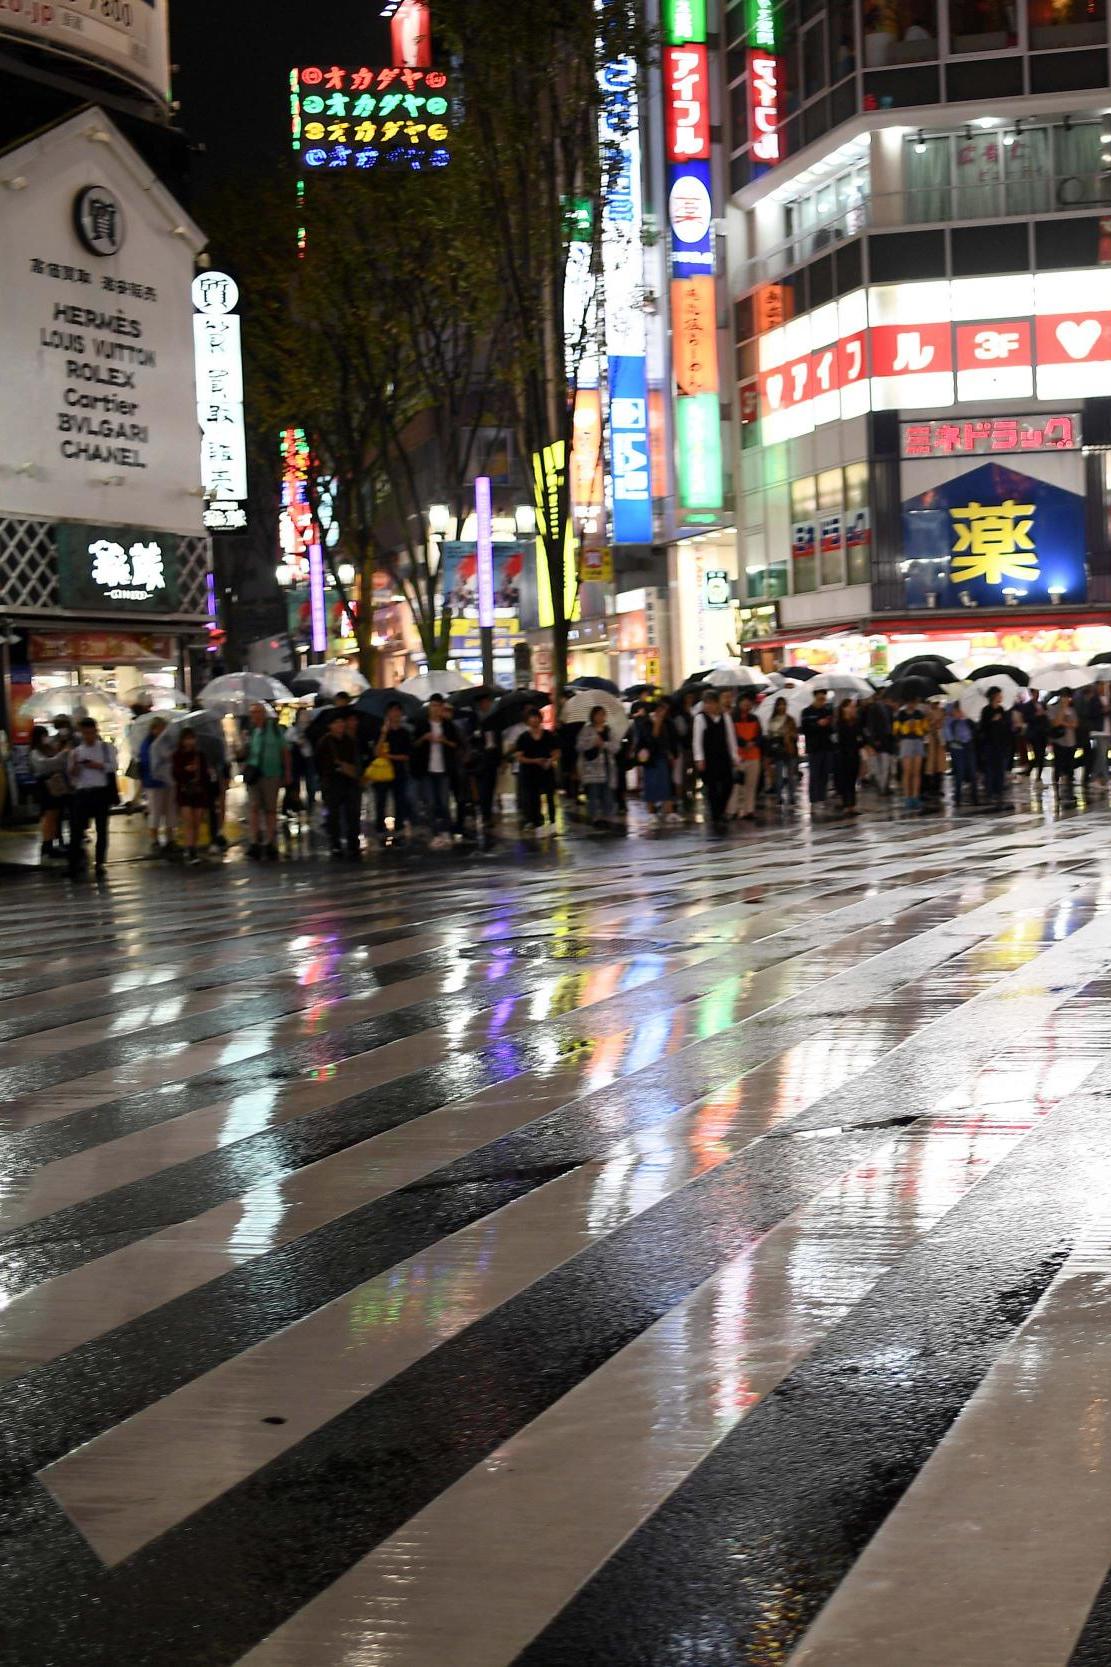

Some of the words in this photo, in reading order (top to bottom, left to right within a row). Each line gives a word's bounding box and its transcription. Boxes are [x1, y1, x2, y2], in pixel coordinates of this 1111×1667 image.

[671, 52, 704, 154] アイフル
[40, 328, 85, 354] LOUIS
[92, 338, 156, 368] VUITTON
[973, 331, 1021, 360] 3F
[66, 359, 136, 389] ROLEX
[63, 388, 140, 416] Cartier
[56, 412, 149, 443] BVLGARI
[60, 440, 147, 468] CHANEL
[949, 499, 1041, 585] 薬
